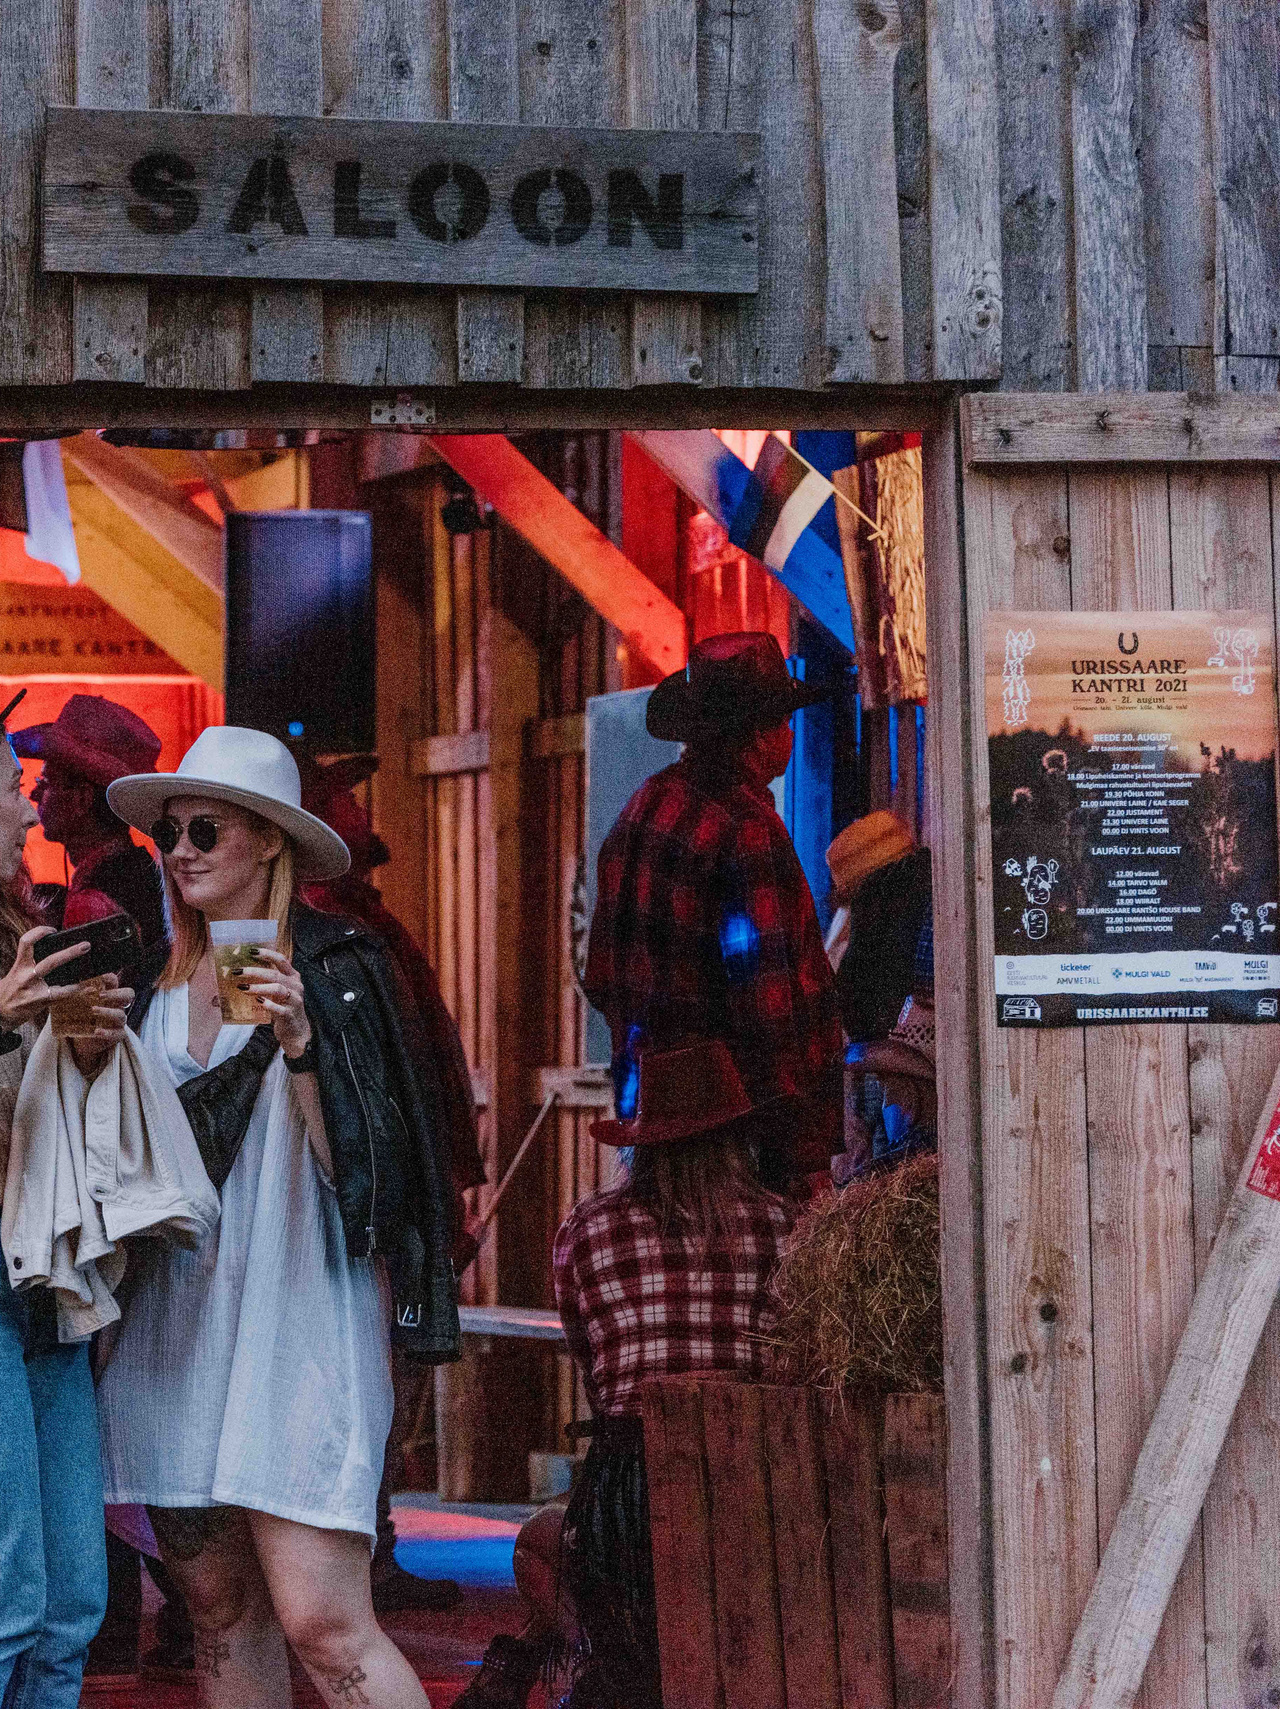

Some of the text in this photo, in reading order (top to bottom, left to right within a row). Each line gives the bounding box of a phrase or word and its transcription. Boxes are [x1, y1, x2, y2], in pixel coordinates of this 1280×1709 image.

[124, 149, 685, 250] SALOON
[1071, 659, 1187, 675] URISSAARE
[1071, 678, 1188, 693] KANTRI 2021
[1136, 696, 1165, 705] august
[1093, 733, 1172, 742] REEDE 20. AUGUST
[1076, 782, 1108, 790] Mulgimaa
[1123, 789, 1144, 798] PÕHJA
[1145, 790, 1165, 798] KONN
[1080, 800, 1099, 808] 21.00
[1091, 845, 1182, 856] LAUPÄEV 21. AUGUST
[1116, 898, 1134, 906] 18.00
[1105, 926, 1124, 934] 00.00
[1060, 963, 1092, 971] ticketer
[1243, 960, 1269, 969] MULGI
[1124, 970, 1149, 978] MULGI
[1076, 1007, 1209, 1019] URISSAAREKANTRI.EE
